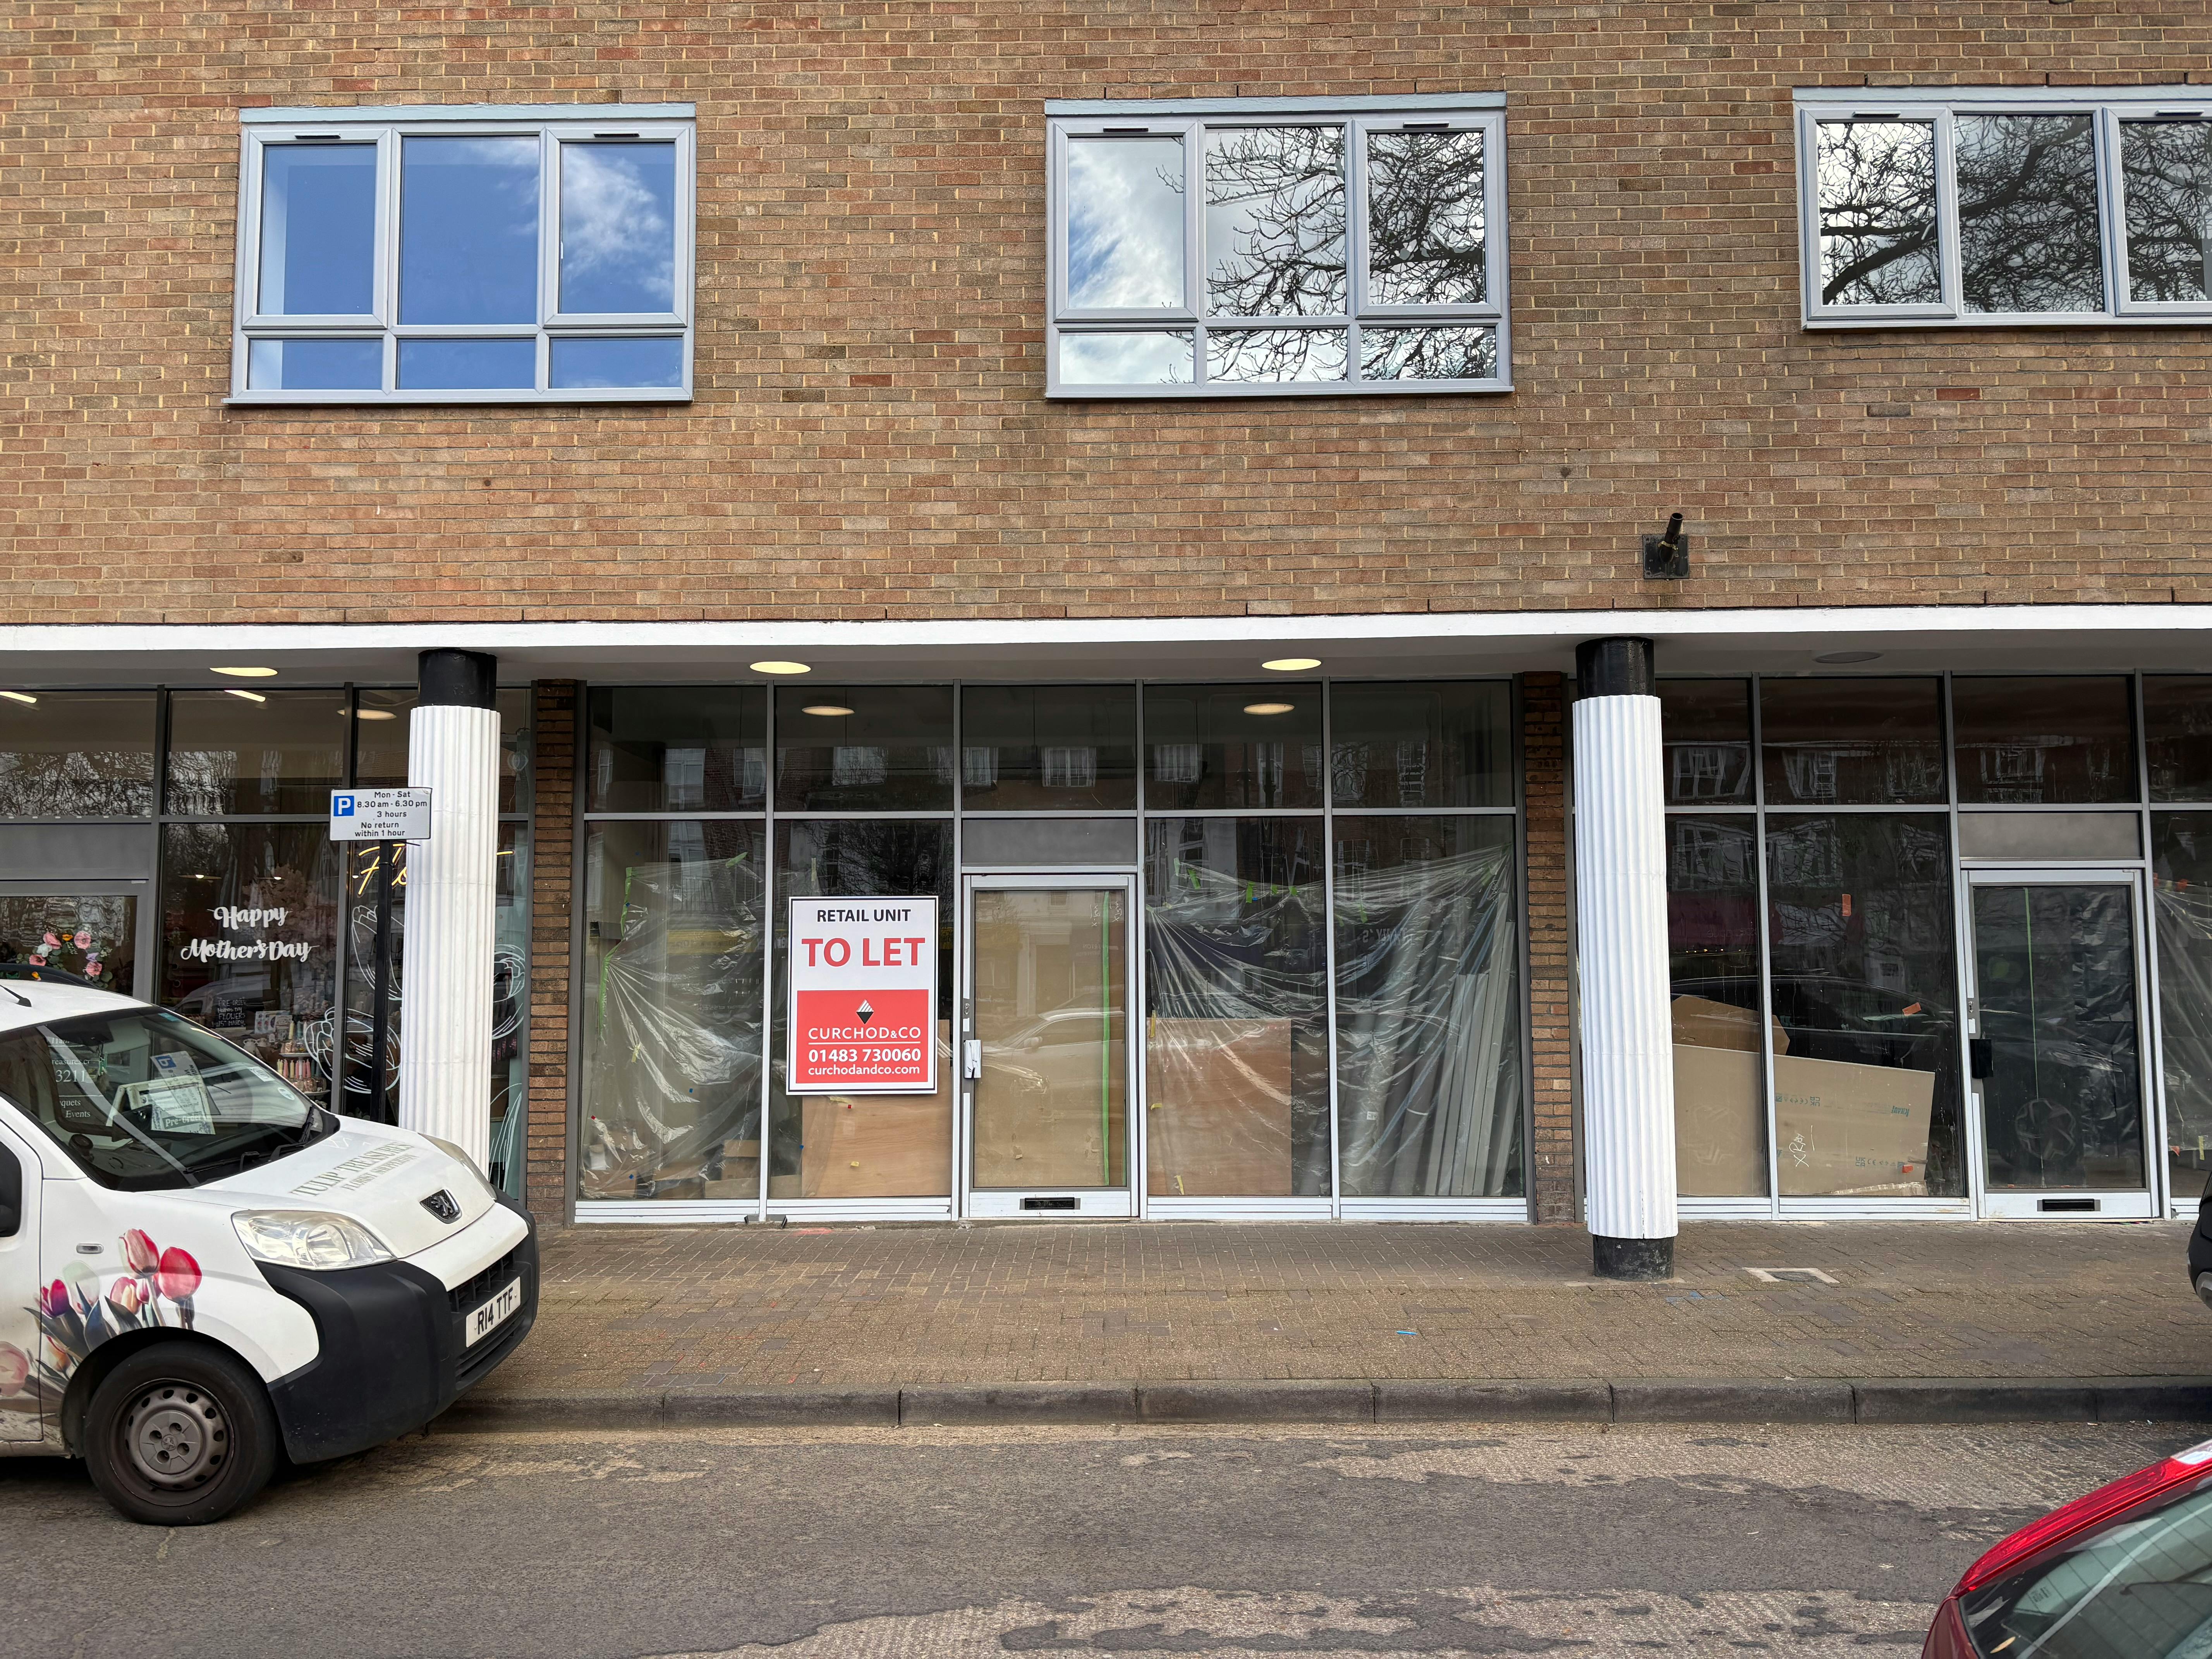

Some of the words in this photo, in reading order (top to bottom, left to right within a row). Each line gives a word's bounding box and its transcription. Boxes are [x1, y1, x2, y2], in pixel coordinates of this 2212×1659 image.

[338, 798, 351, 815] P
[214, 906, 289, 930] Happy
[817, 909, 869, 922] RETAIL
[874, 909, 911, 922] UNIT
[180, 939, 267, 963] Mother's
[269, 941, 312, 962] Day
[802, 938, 851, 967] TO
[863, 938, 925, 966] LET
[808, 1027, 921, 1039] CURCHOD&CO
[809, 1049, 858, 1062] 01483
[862, 1048, 921, 1061] 730060
[808, 1064, 920, 1075] curchodandco.com
[65, 1110, 91, 1118] Events
[289, 1171, 347, 1196] TULIP
[333, 1142, 414, 1172] TREASURES
[340, 1173, 378, 1191] FLORIST
[477, 1303, 494, 1335] R14
[497, 1286, 513, 1319] TTF
